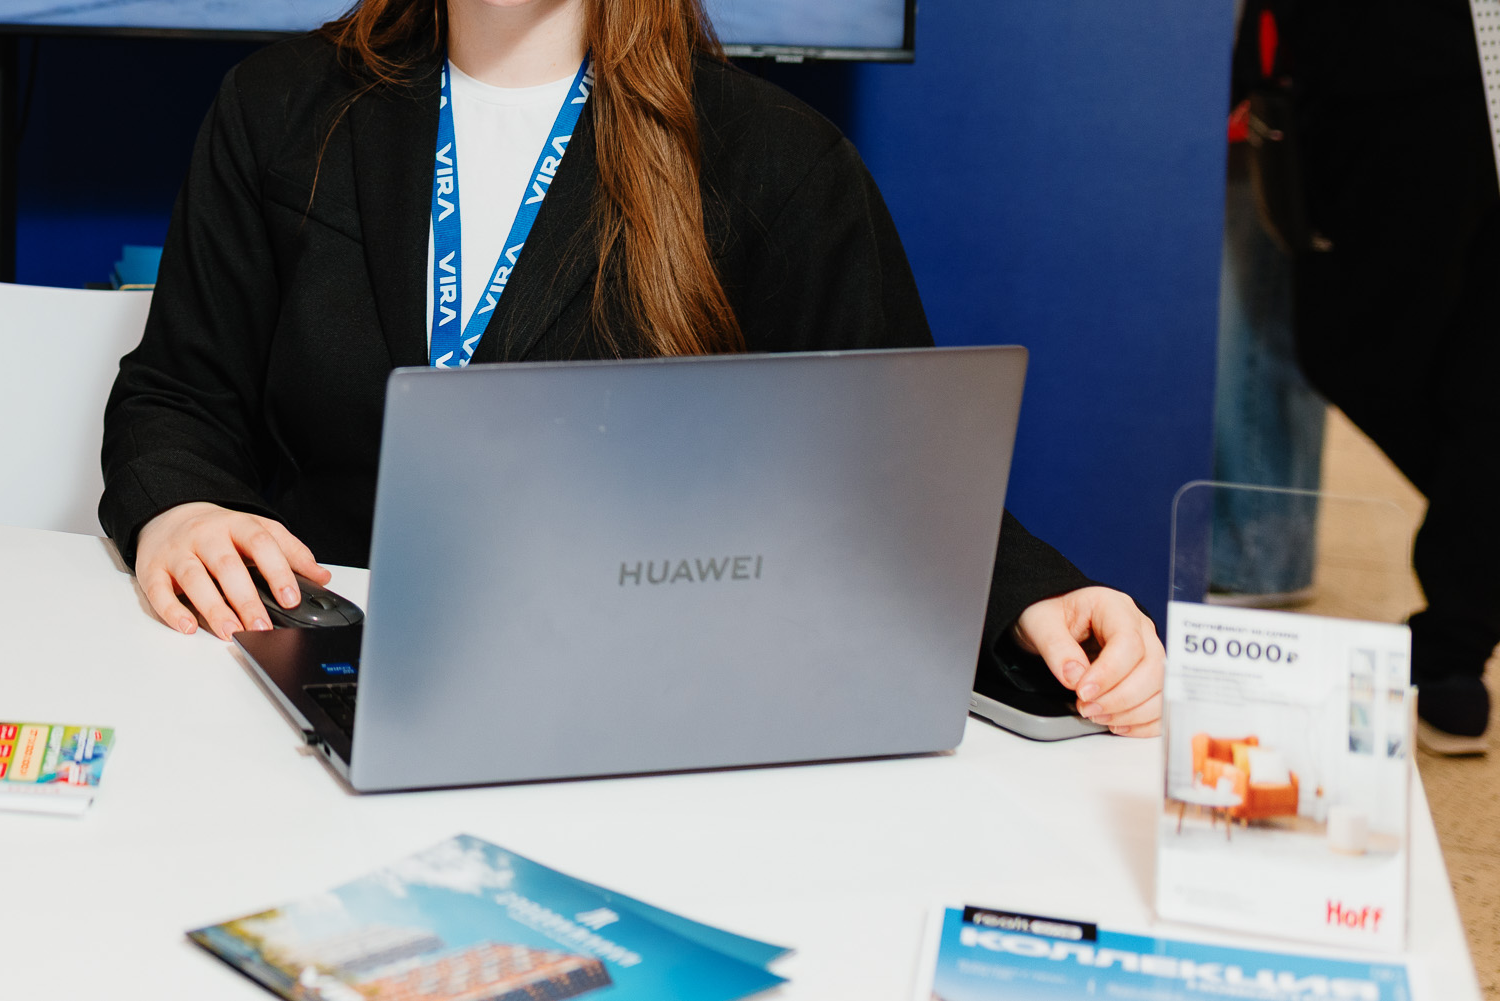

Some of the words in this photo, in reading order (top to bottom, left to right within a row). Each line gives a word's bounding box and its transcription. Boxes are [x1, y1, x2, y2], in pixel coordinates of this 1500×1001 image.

[435, 142, 456, 223] VIRA
[524, 134, 573, 206] VIRA
[438, 250, 457, 327] VIRA
[477, 242, 525, 315] VIRA
[618, 554, 764, 588] HUAWEI
[1184, 634, 1218, 656] 50
[1326, 898, 1385, 934] Hoff
